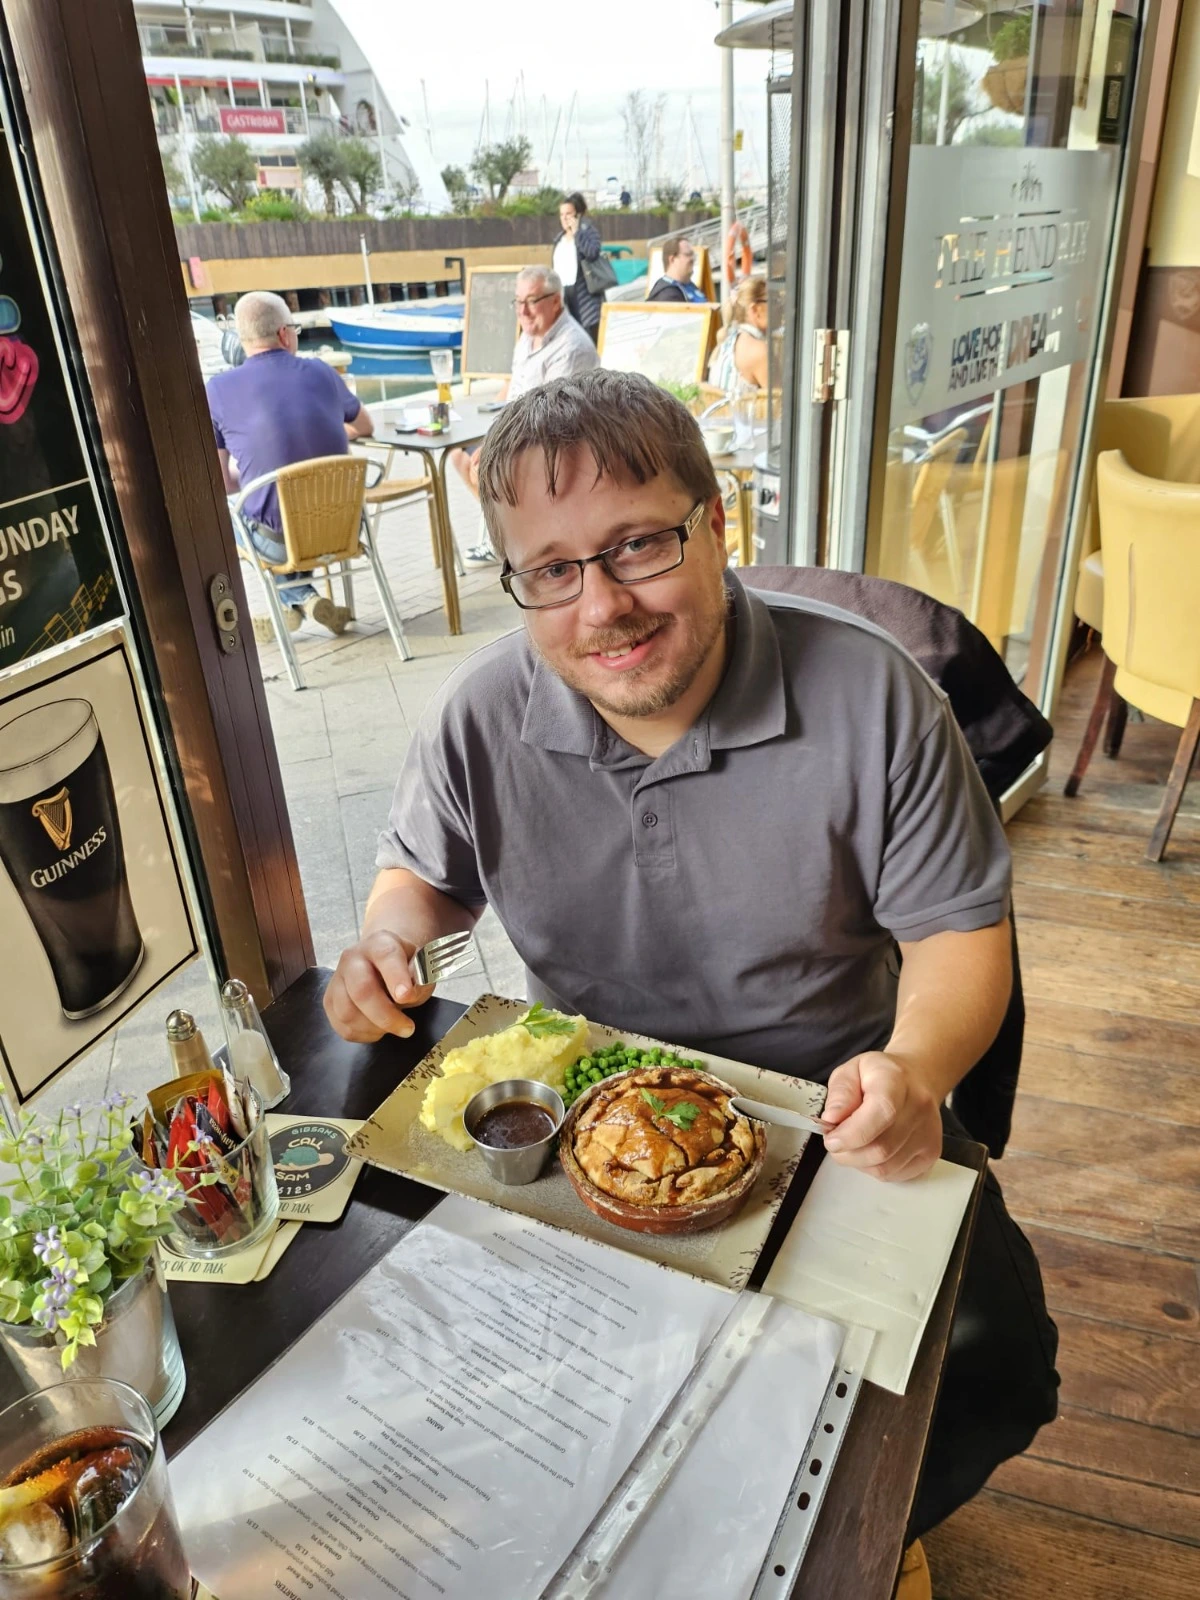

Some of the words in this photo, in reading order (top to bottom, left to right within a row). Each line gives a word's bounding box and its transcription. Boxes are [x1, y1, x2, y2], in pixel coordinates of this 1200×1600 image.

[951, 326, 982, 367] LOVE
[30, 826, 107, 888] GUINNESS
[291, 1126, 338, 1139] GIBSAMS
[288, 1137, 323, 1150] CALL
[276, 1171, 310, 1181] SAM
[291, 1203, 314, 1213] TALK
[171, 1260, 187, 1272] OK
[188, 1262, 201, 1273] TO
[203, 1262, 227, 1274] TALK
[425, 1415, 445, 1431] MAINS
[370, 1479, 388, 1494] Nachos
